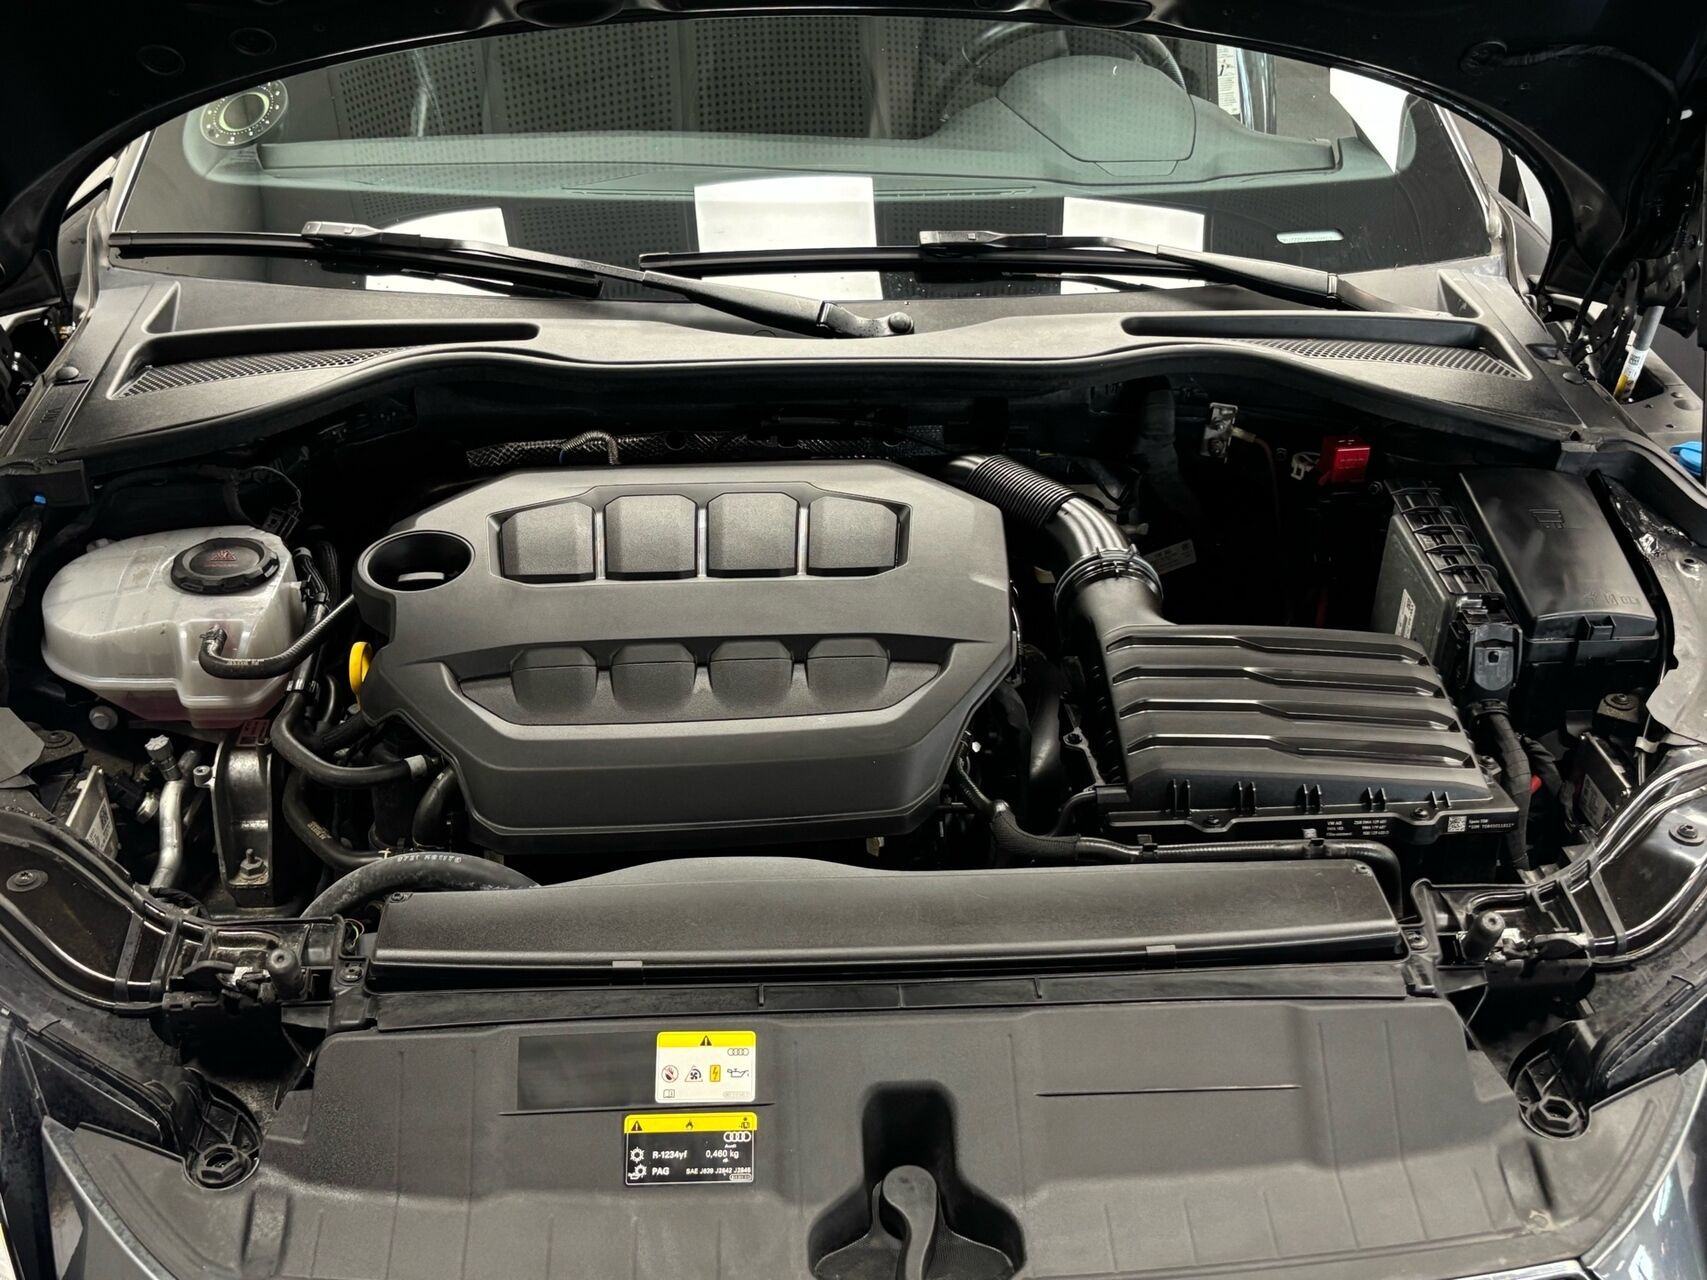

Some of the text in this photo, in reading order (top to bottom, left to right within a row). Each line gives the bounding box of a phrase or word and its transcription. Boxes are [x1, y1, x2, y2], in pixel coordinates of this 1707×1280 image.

[651, 1149, 688, 1160] R-1234yf
[729, 1149, 740, 1159] kg
[651, 1167, 670, 1176] PAG
